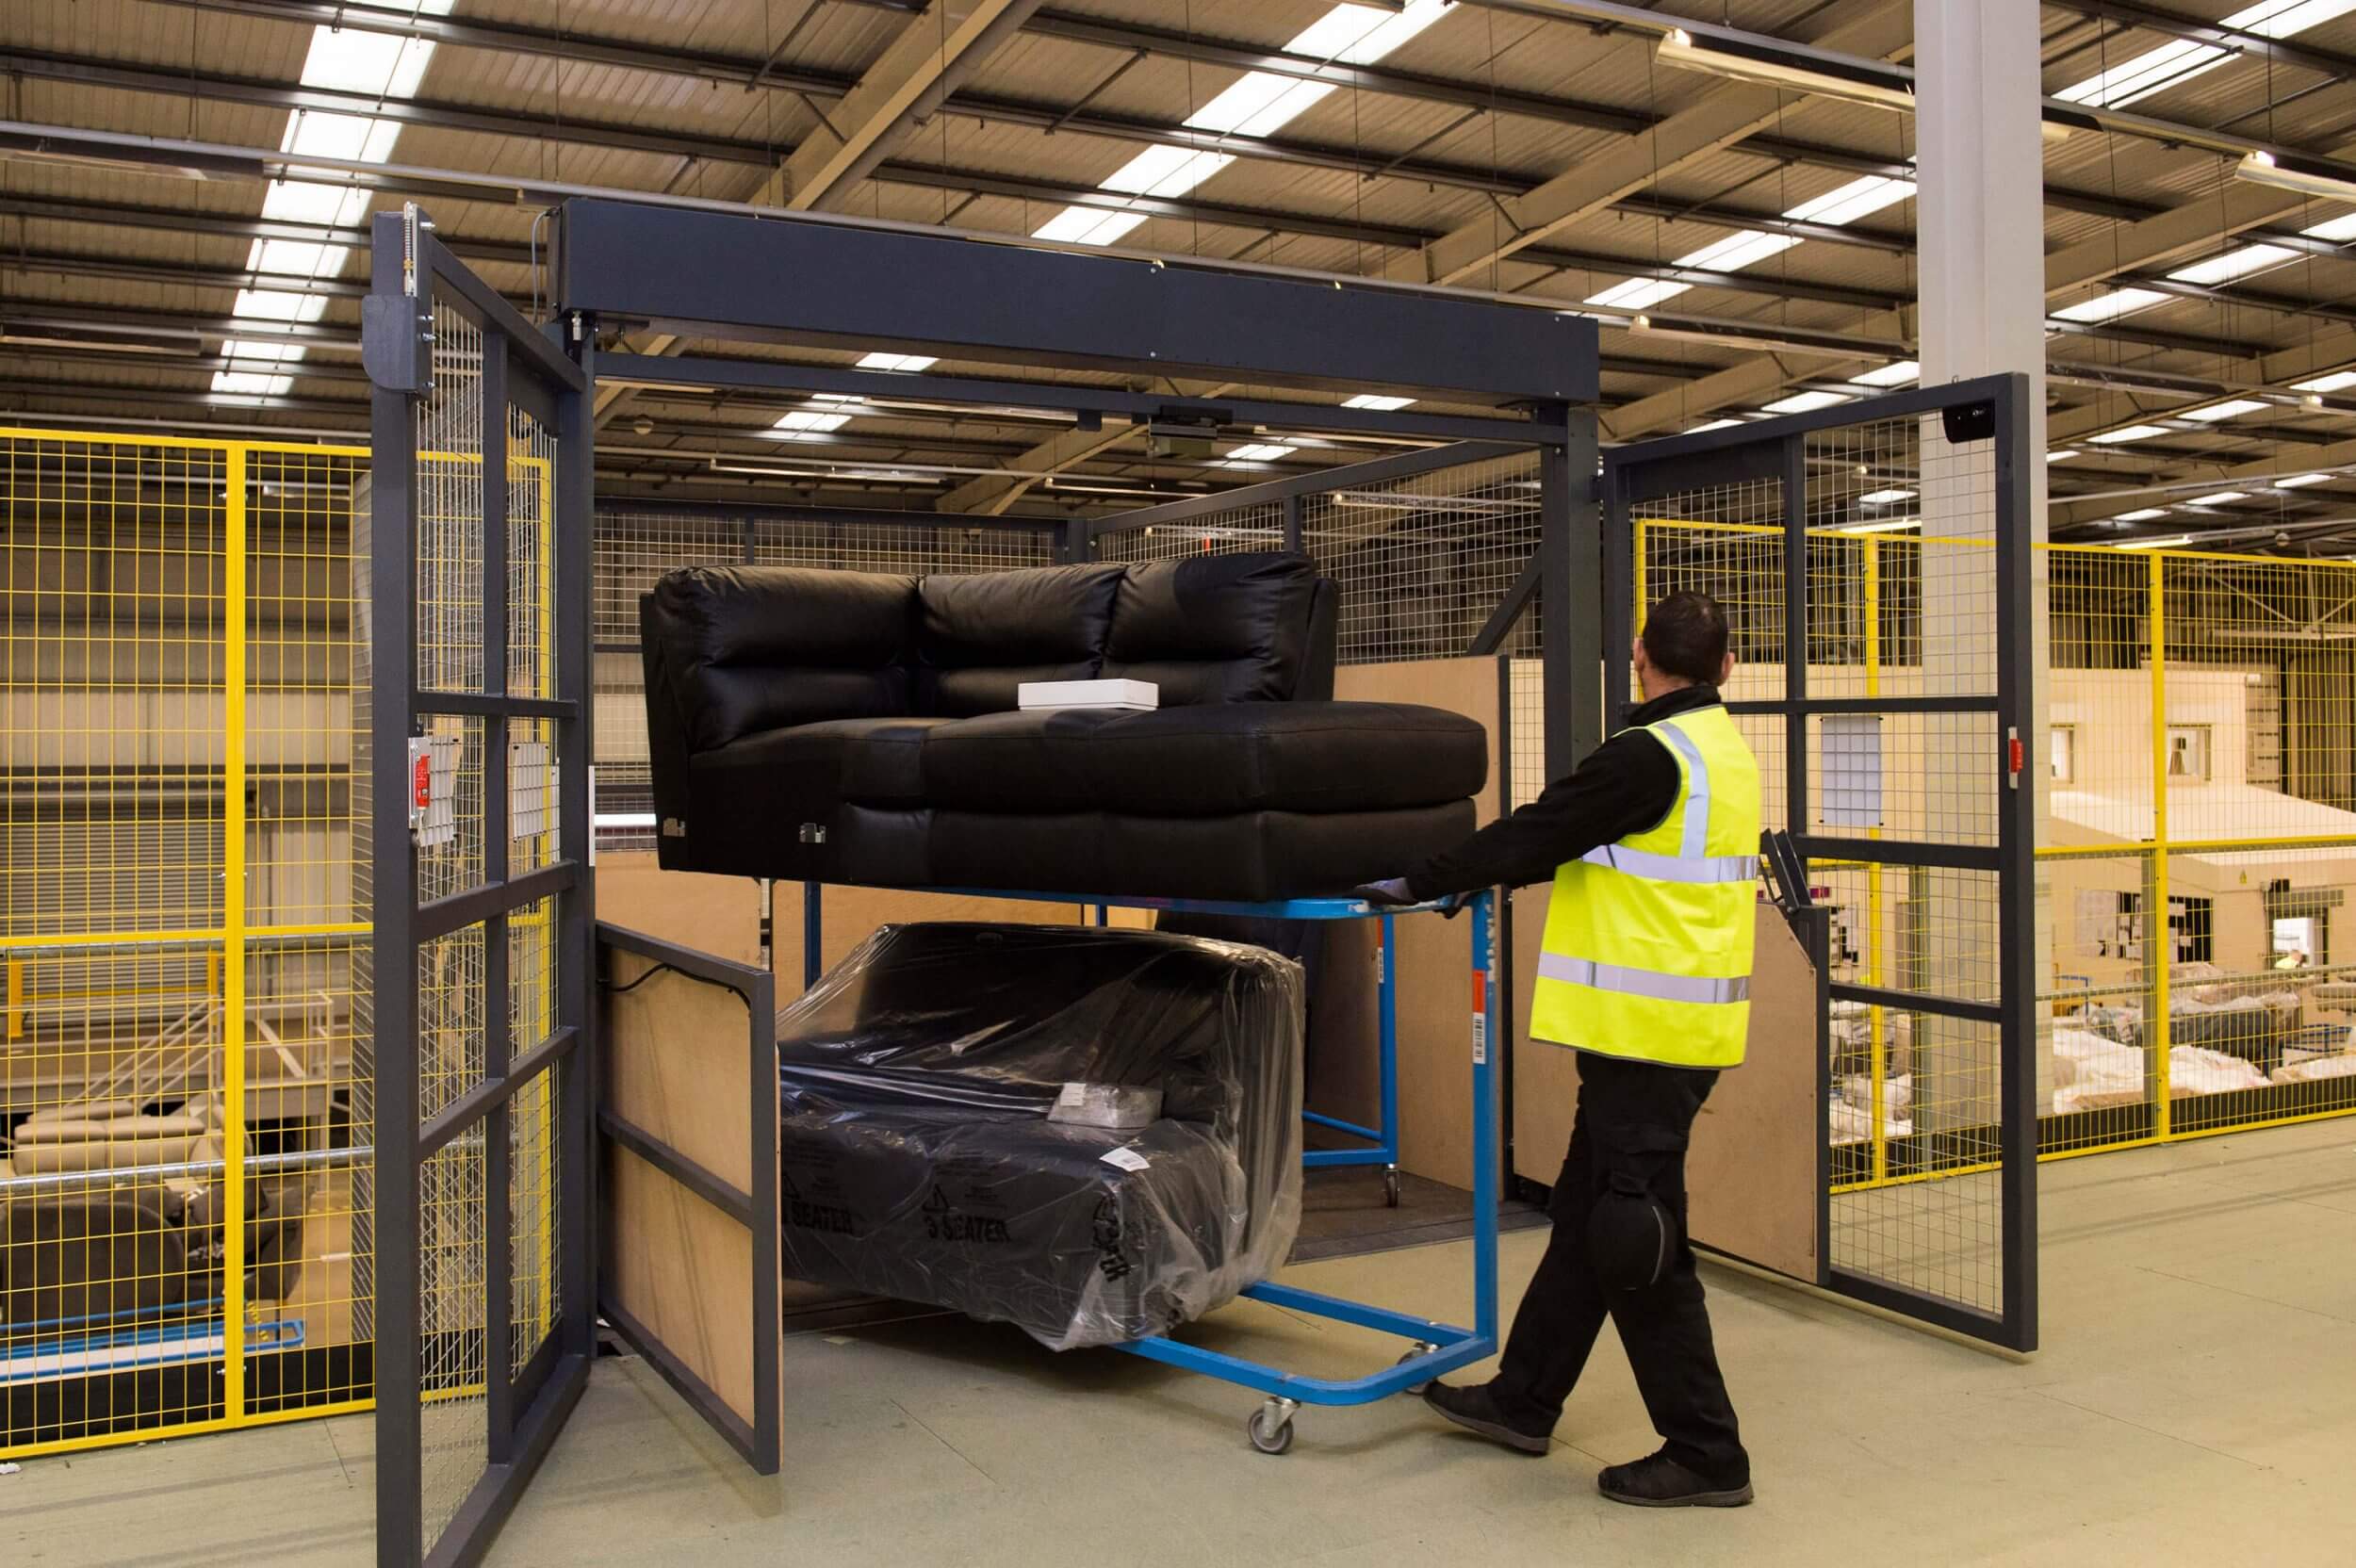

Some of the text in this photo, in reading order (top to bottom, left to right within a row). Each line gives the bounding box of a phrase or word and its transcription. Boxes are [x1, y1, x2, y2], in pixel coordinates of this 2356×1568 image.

[792, 1201, 853, 1234] SEATER
[923, 1214, 1011, 1243] 3 SEATER
